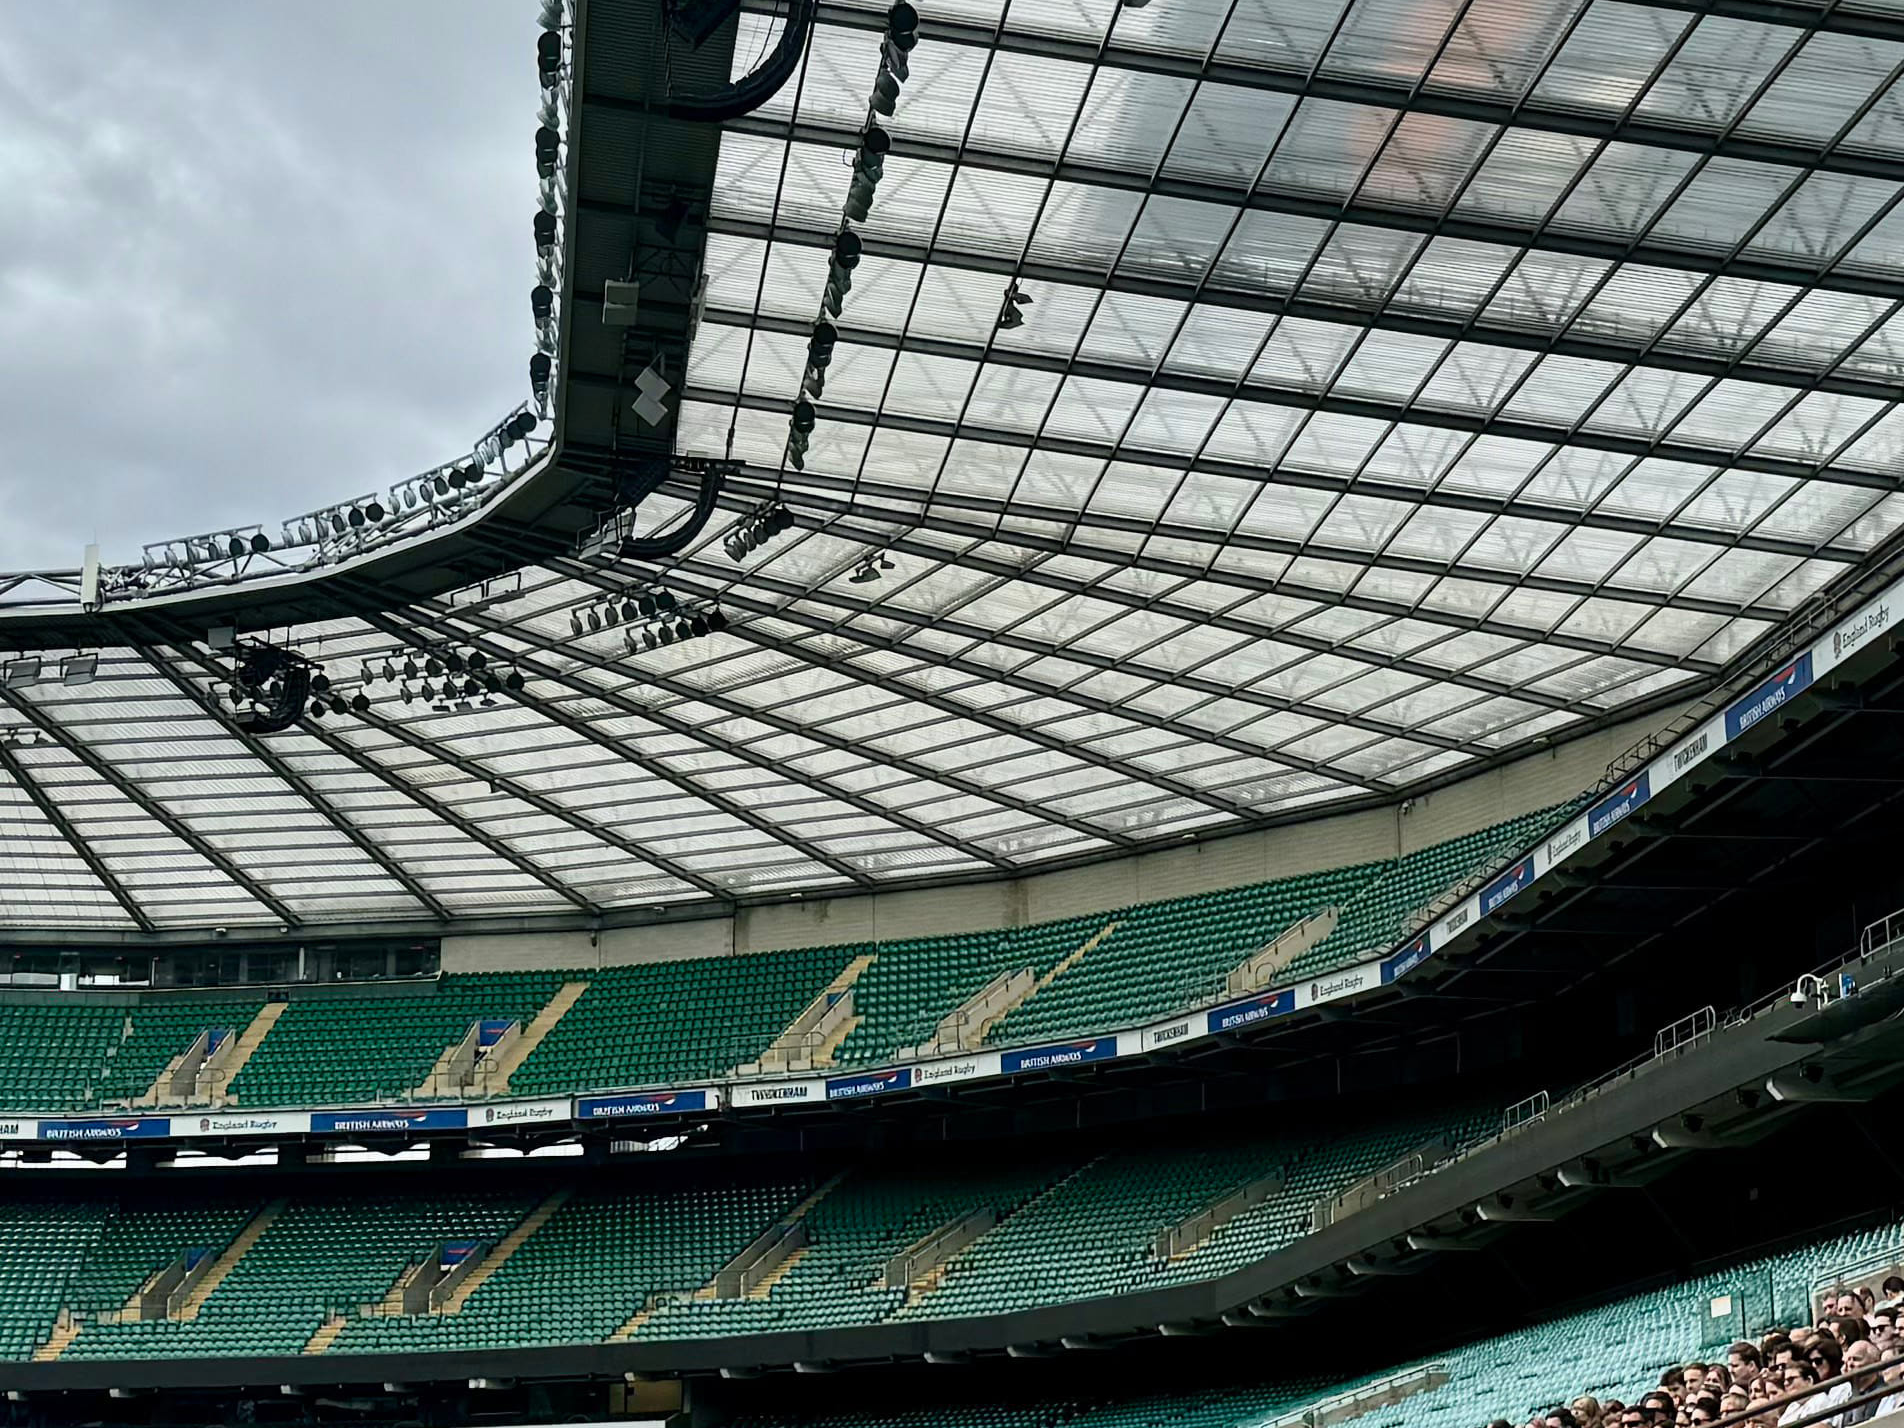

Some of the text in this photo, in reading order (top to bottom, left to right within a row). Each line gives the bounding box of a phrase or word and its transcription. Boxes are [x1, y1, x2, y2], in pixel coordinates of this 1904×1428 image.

[1842, 604, 1890, 649] England Rugby
[212, 1120, 249, 1132] England
